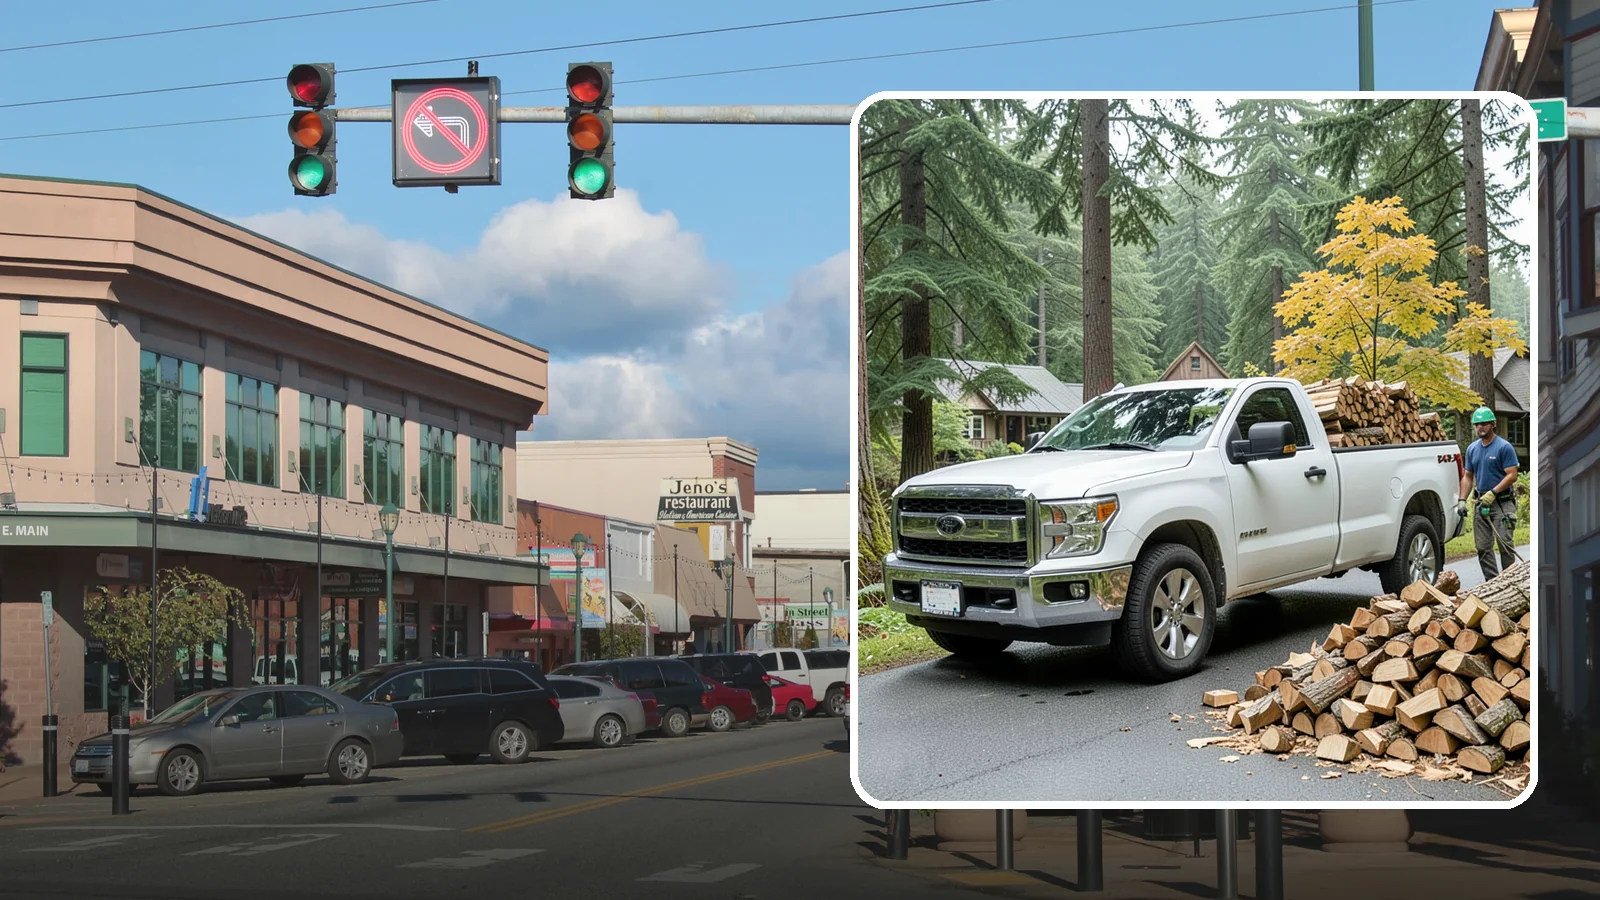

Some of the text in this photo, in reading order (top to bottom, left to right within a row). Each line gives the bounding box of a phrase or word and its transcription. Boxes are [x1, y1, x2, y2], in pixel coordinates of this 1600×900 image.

[669, 480, 727, 494] Jeno's
[665, 496, 731, 509] restaurant
[686, 510, 714, 519] American
[715, 510, 737, 519] Cuisine
[2, 525, 49, 536] E. MAIN
[797, 607, 828, 617] Street
